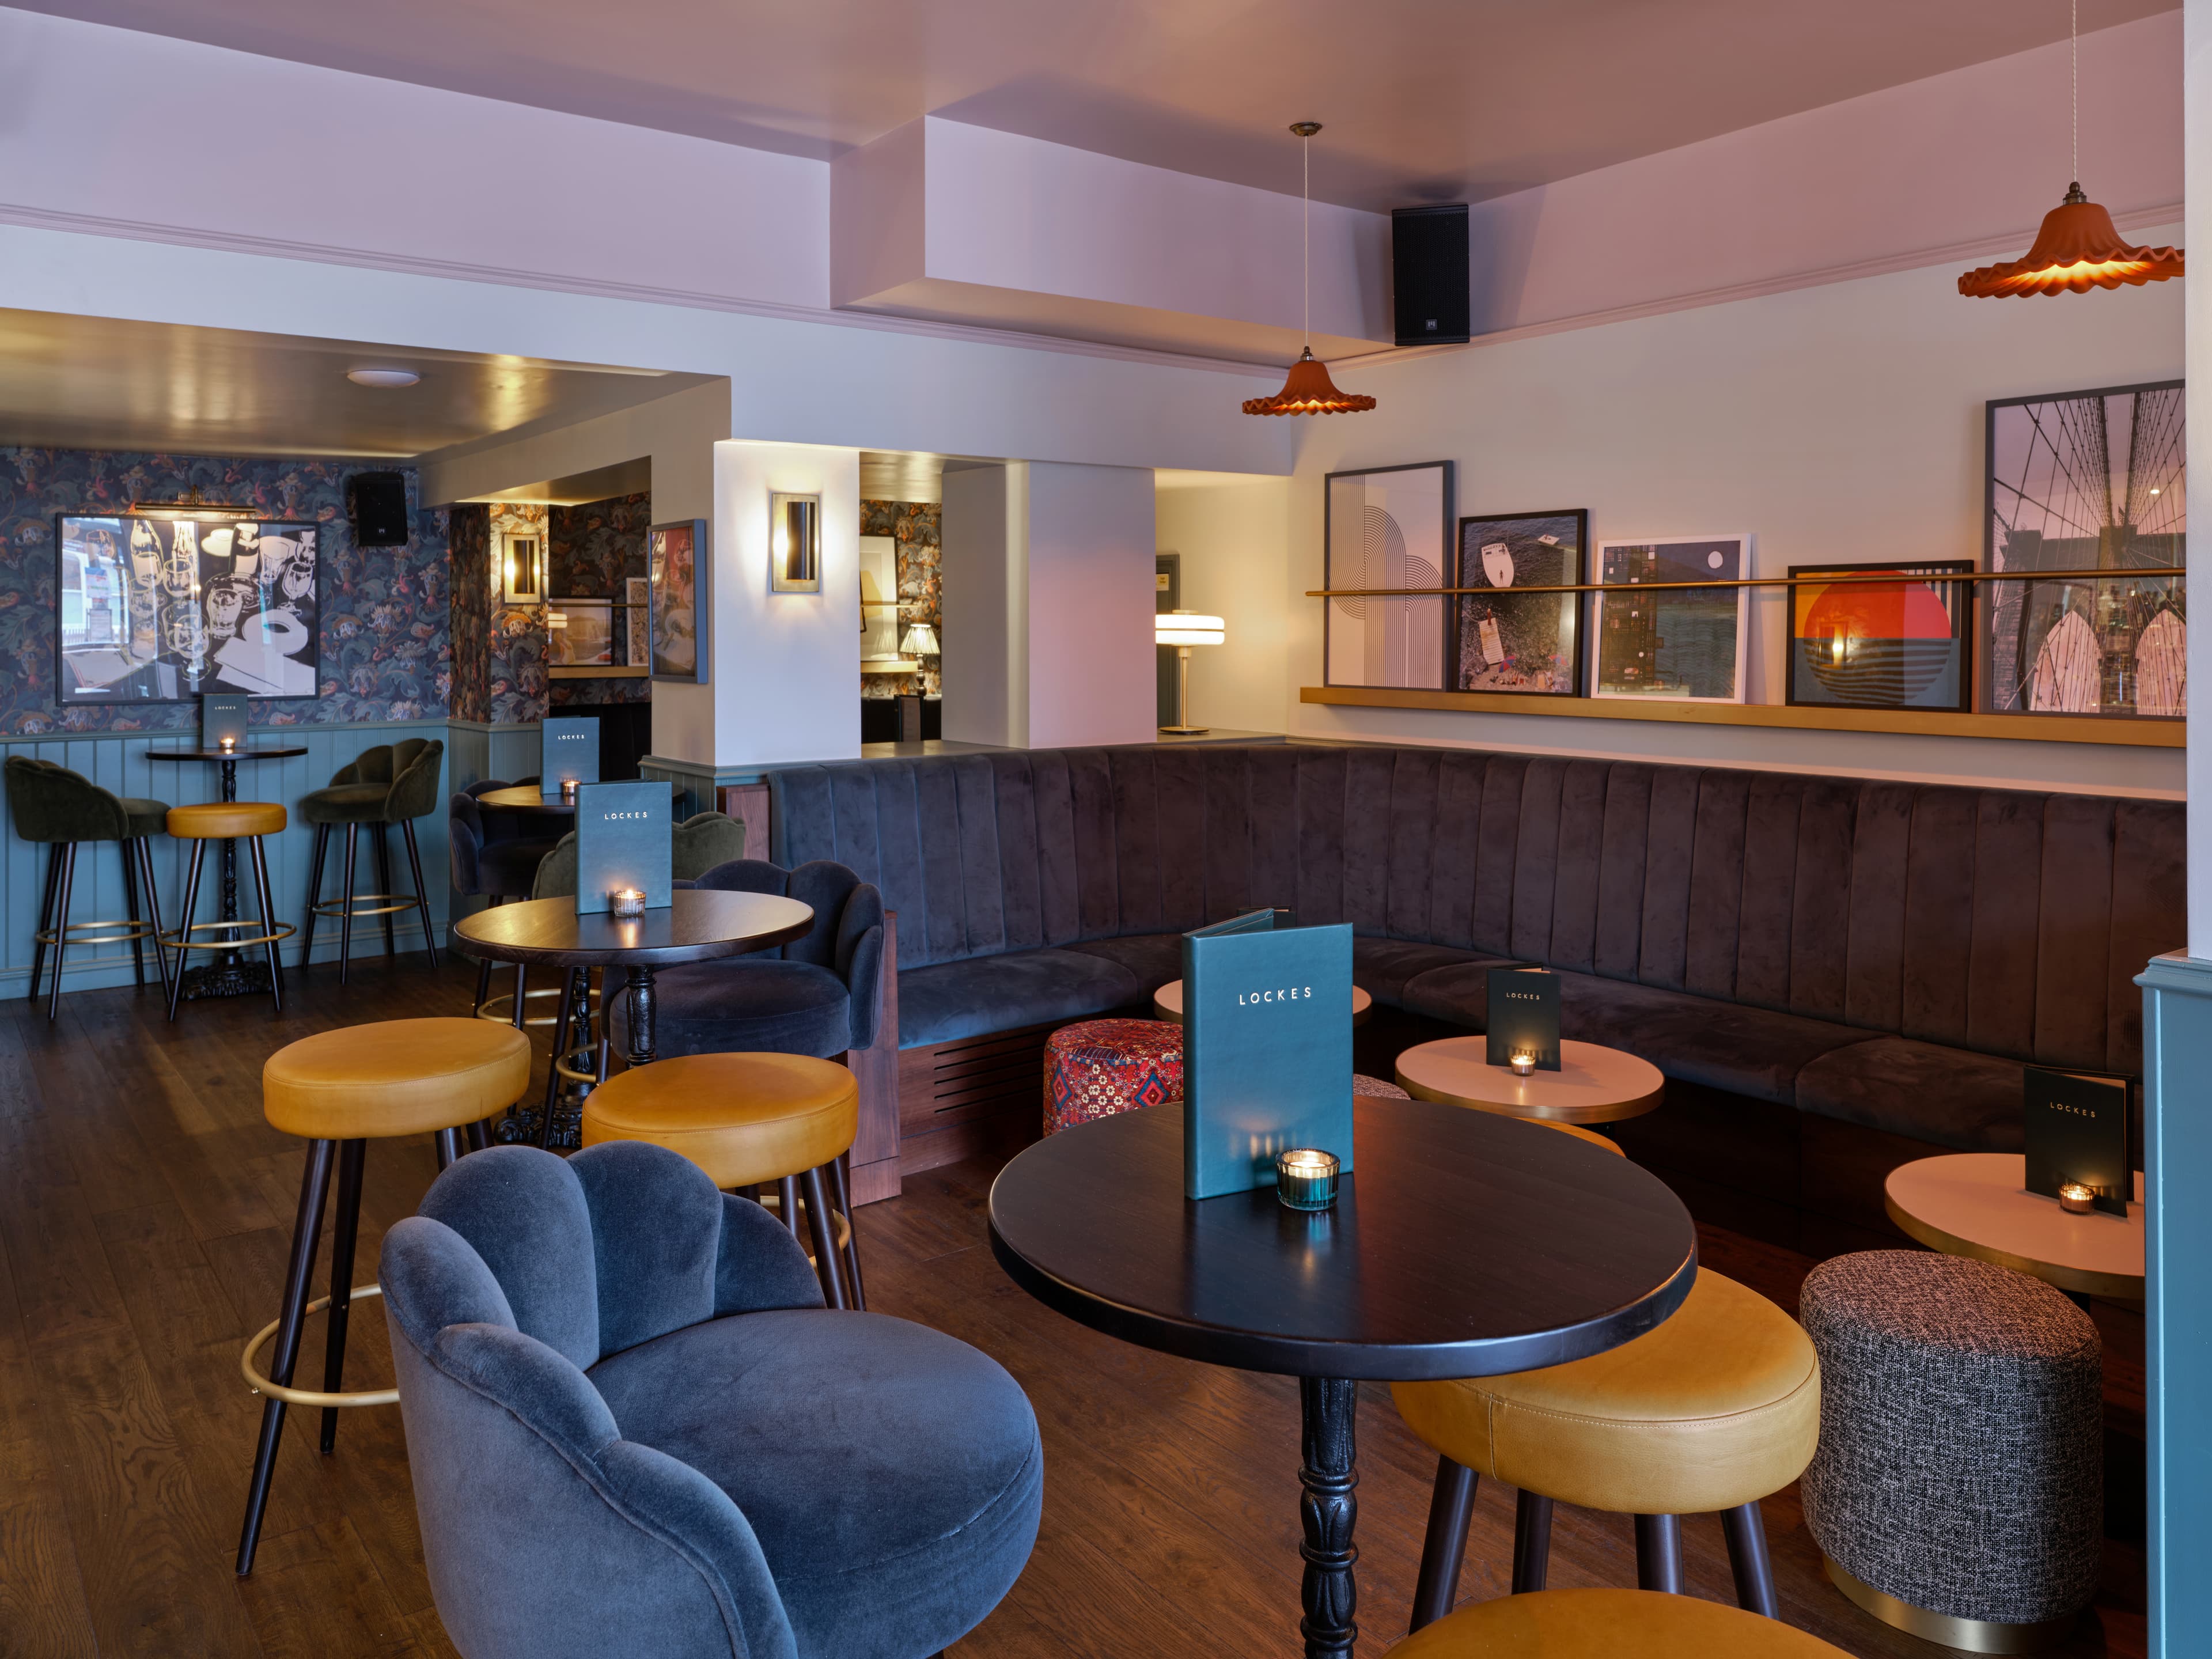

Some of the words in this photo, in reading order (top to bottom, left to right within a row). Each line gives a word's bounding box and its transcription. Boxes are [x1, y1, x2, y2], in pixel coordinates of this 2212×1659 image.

[604, 812, 647, 820] LOCKES
[1239, 987, 1311, 1005] LOCKES
[2050, 1101, 2096, 1118] LOCKES
